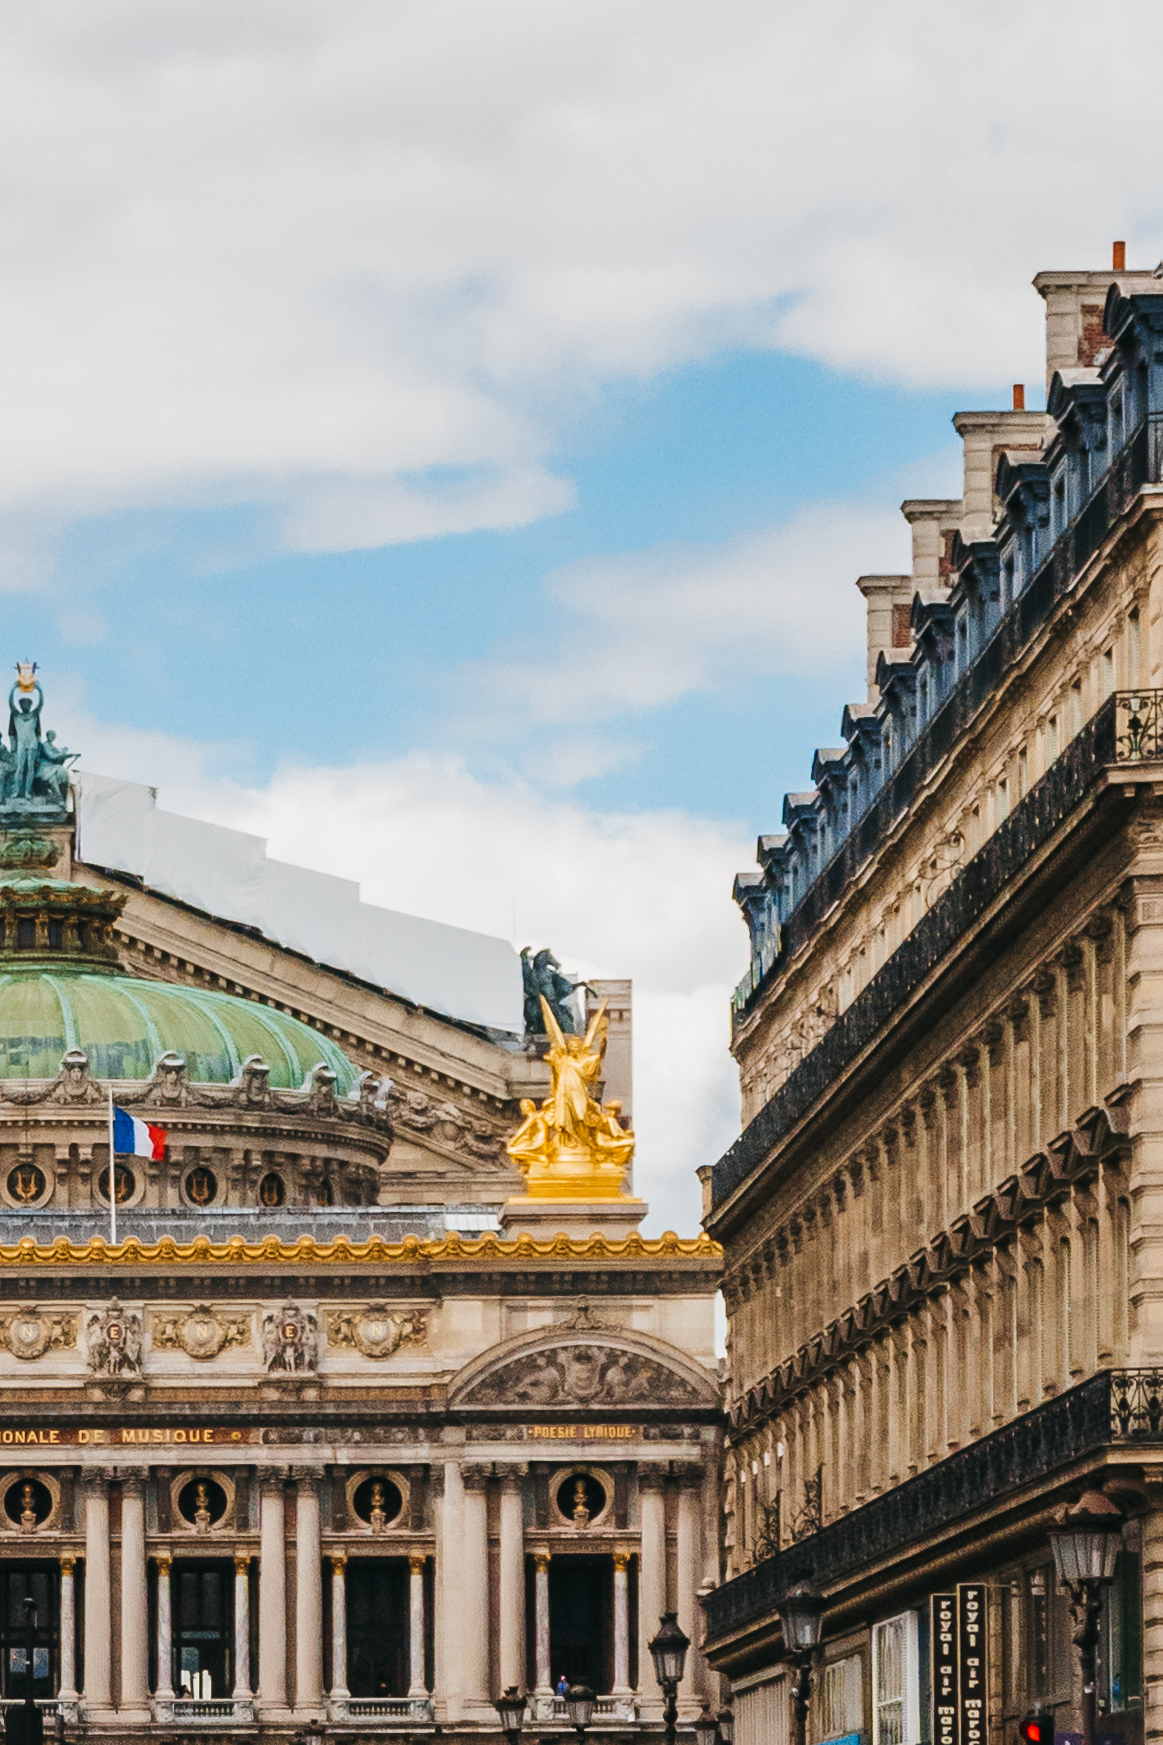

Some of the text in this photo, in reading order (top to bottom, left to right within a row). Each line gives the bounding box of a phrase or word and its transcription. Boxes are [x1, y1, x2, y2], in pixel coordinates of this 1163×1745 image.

[22, 1326, 33, 1338] N
[110, 1326, 119, 1338] E
[196, 1326, 208, 1338] N
[285, 1326, 294, 1338] E
[78, 1429, 105, 1443] DE
[121, 1429, 214, 1443] MUSIQUE
[966, 1590, 979, 1647] royal
[939, 1600, 953, 1655] royal
[966, 1657, 980, 1688] air
[939, 1665, 953, 1696] air
